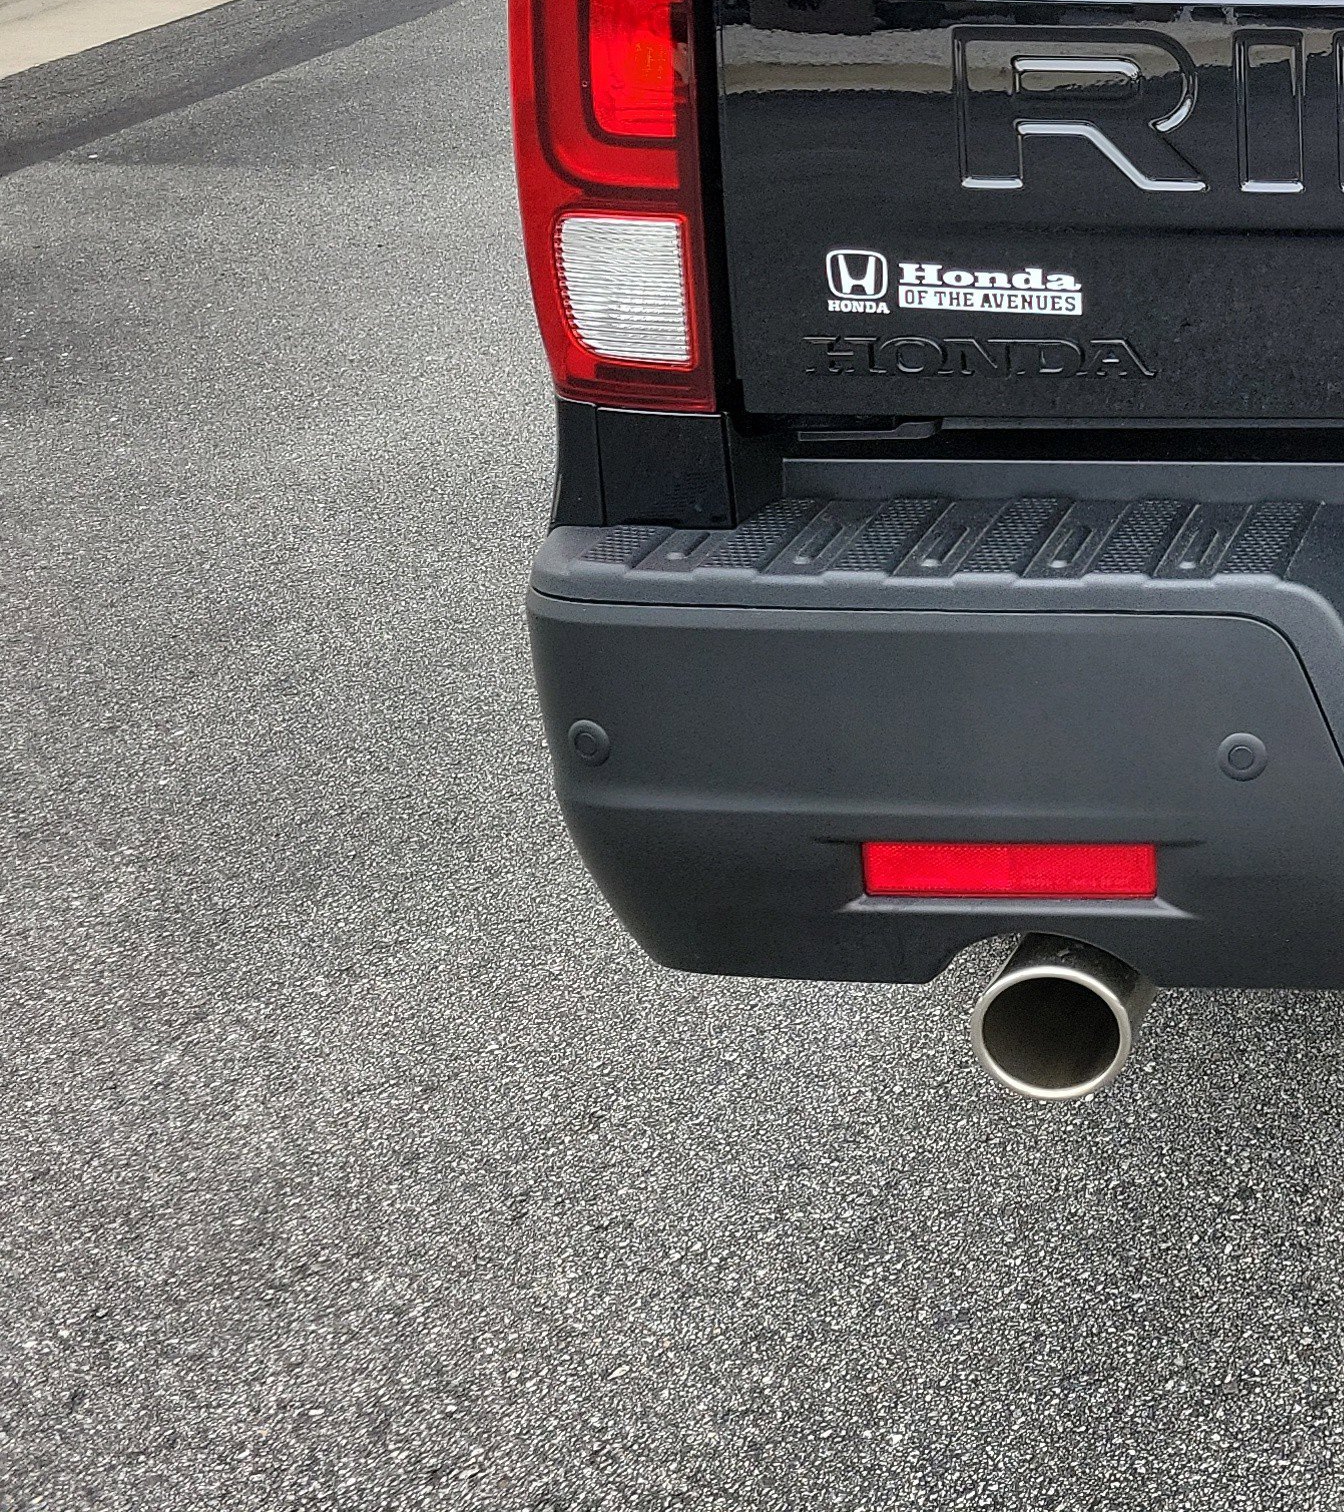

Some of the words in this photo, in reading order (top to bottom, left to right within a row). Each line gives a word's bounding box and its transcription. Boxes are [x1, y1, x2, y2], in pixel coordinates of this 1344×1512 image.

[899, 263, 1082, 291] Honda
[828, 300, 890, 314] HONDA
[905, 291, 929, 304] OF
[934, 292, 974, 307] THE
[980, 294, 1076, 312] AVENUES
[804, 337, 1157, 377] HONDA
